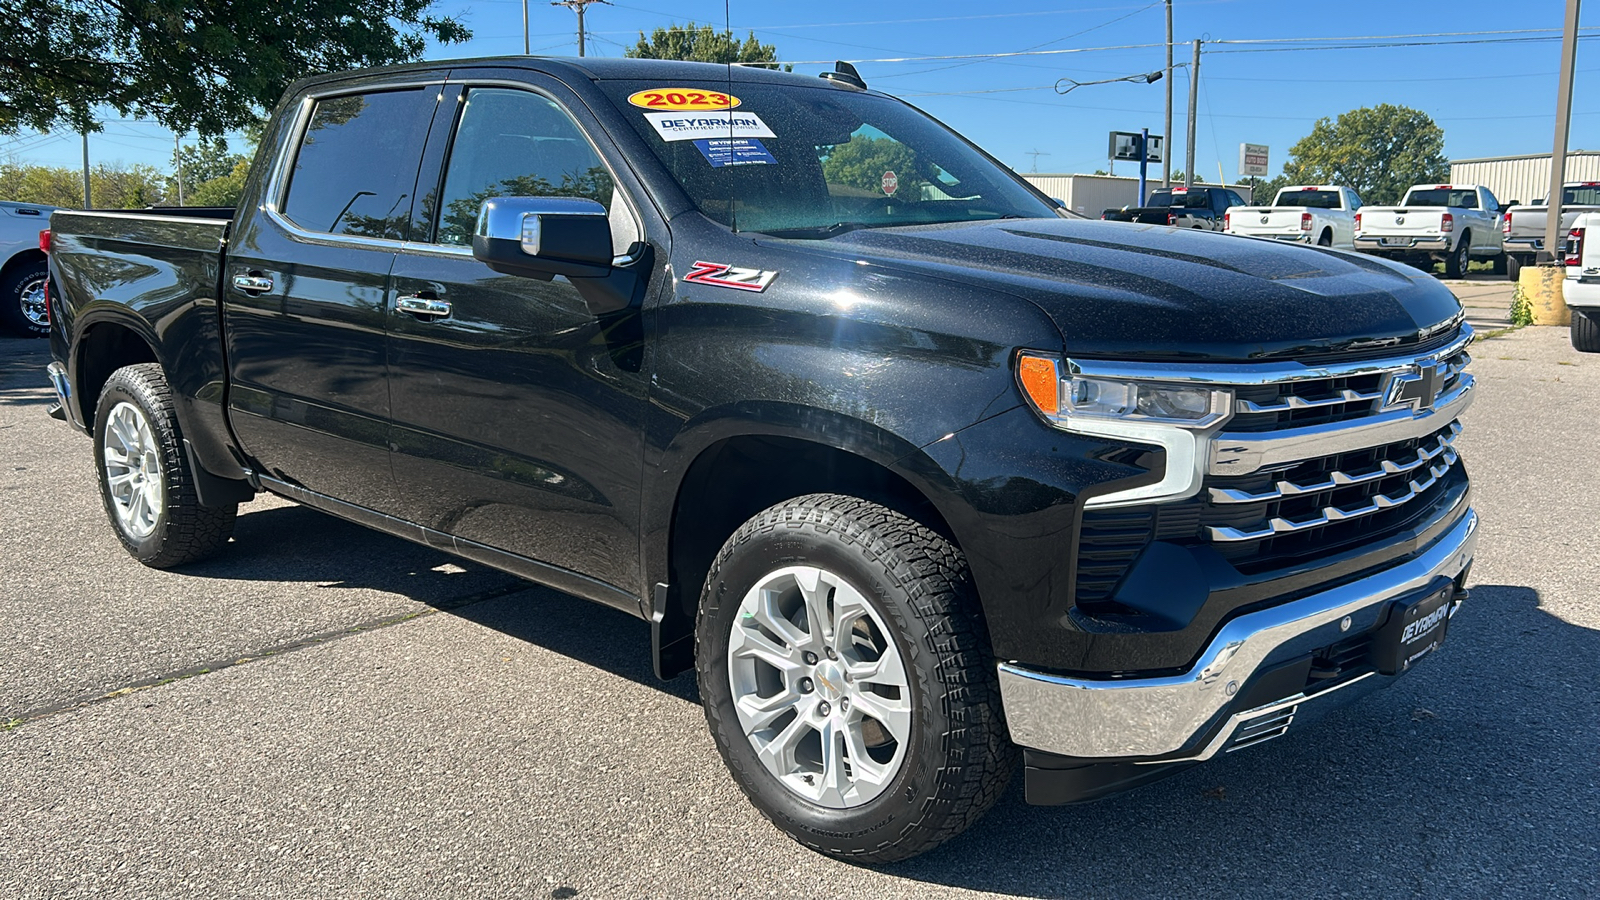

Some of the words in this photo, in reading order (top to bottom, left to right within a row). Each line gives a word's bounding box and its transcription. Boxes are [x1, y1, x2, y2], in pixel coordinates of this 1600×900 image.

[643, 93, 730, 106] 2023
[661, 118, 758, 129] DEYARMAN
[1246, 156, 1257, 164] AUTO
[1257, 157, 1267, 165] BODY
[882, 178, 898, 187] STOP
[682, 260, 779, 293] Z71
[1401, 602, 1450, 643] DEYARMAN
[868, 575, 934, 803] WRANGLER
